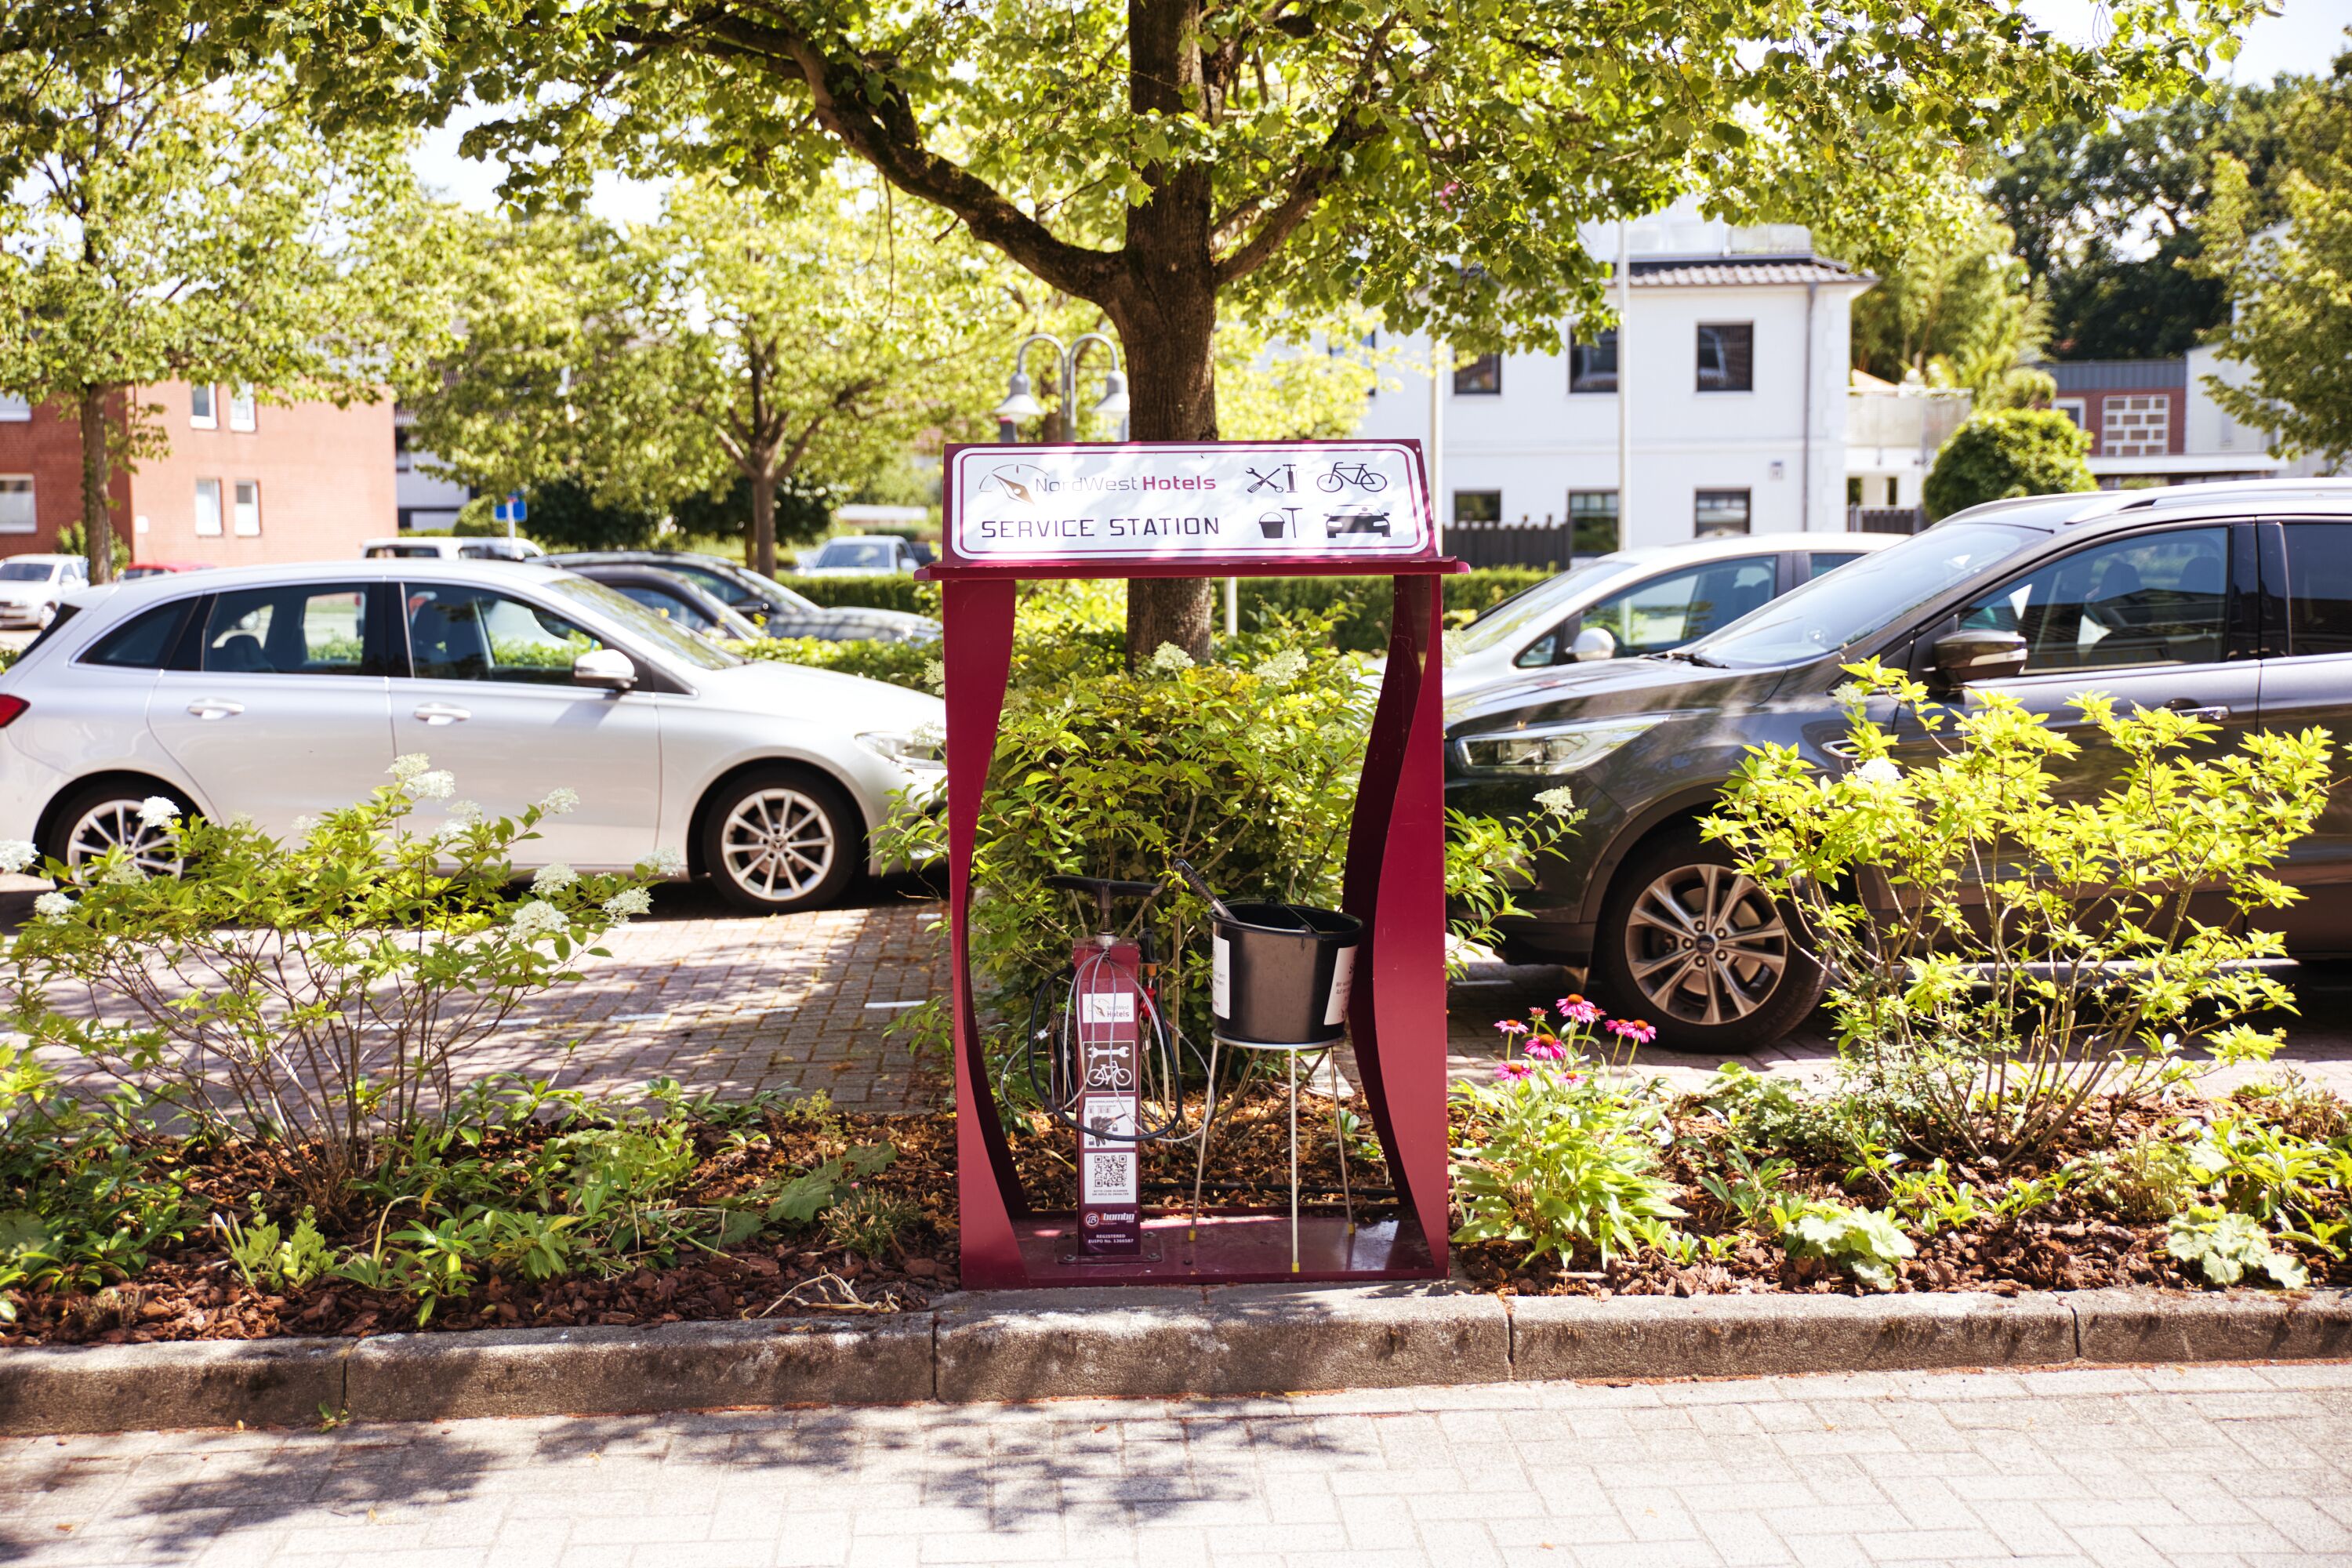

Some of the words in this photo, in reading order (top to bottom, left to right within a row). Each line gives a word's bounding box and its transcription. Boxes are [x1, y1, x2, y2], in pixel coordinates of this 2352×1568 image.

[1036, 476, 1138, 492] NordWest
[1142, 475, 1217, 491] Hotels
[982, 519, 1095, 538] SERVICE
[1109, 517, 1219, 536] STATION
